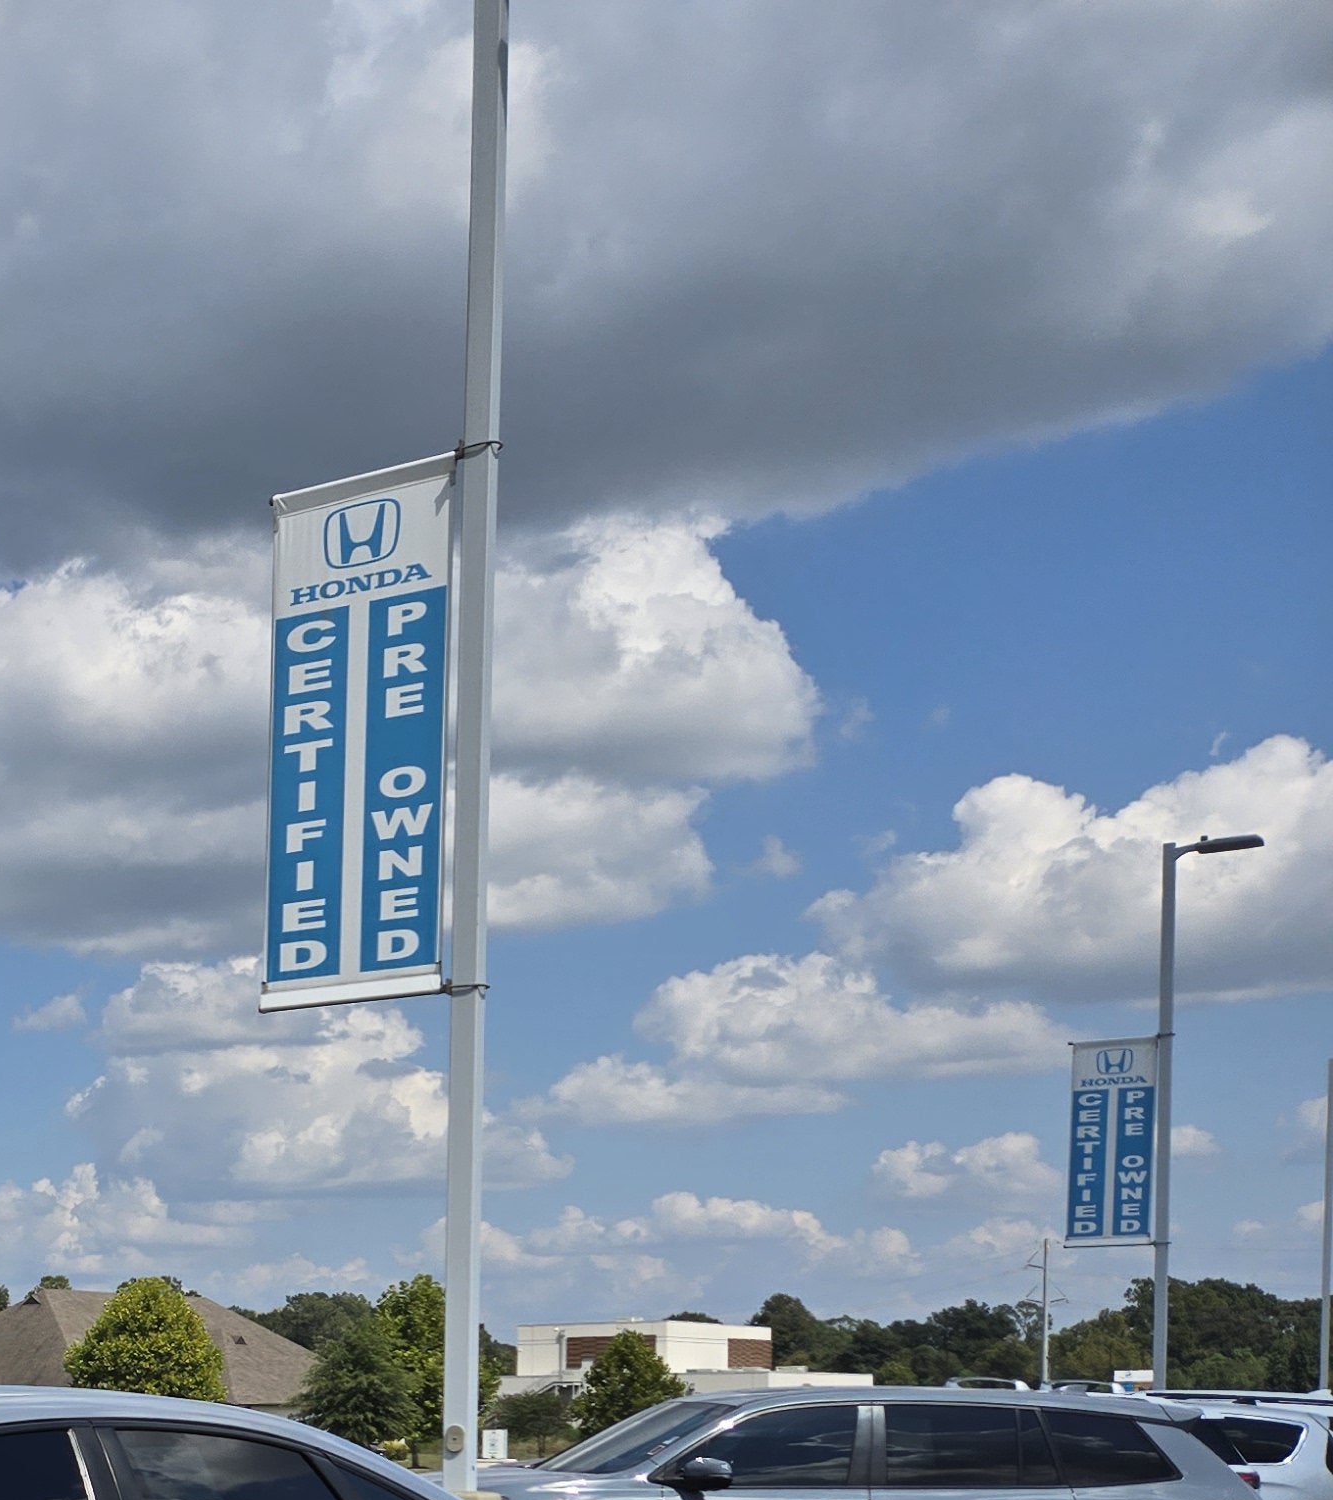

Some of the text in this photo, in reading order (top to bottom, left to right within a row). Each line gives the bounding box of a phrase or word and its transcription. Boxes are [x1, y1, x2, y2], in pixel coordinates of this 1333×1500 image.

[290, 564, 431, 605] HONDA
[279, 620, 336, 973] CERTIFIED
[371, 602, 433, 962] PRE OWNED
[1081, 1076, 1147, 1087] HONDA
[1074, 1094, 1102, 1234] CERTIFIED
[1118, 1091, 1147, 1233] PRE OWNED
